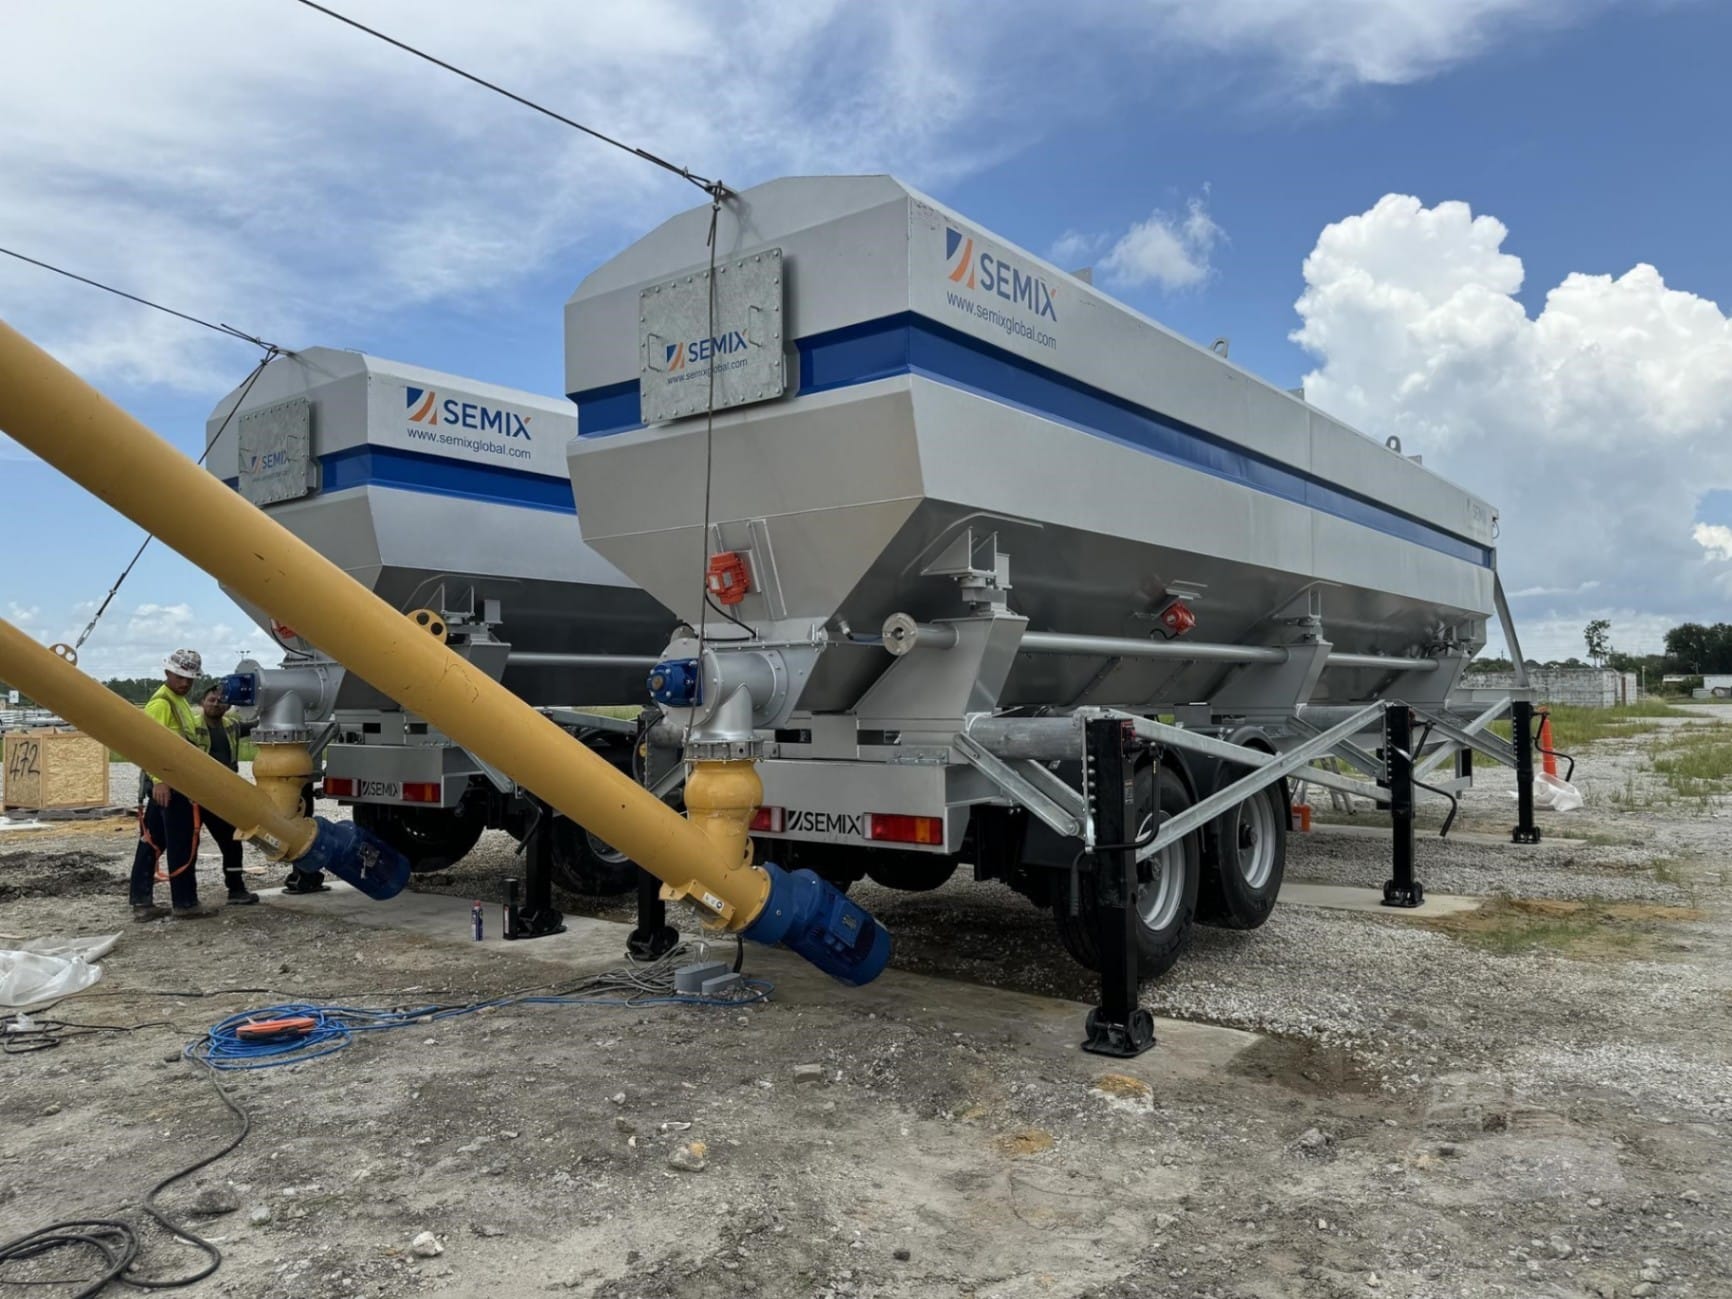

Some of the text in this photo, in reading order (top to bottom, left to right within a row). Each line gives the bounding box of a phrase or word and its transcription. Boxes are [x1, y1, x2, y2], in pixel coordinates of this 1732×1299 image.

[980, 252, 1057, 322] SEMIX
[946, 290, 1057, 350] www.semixglobal.com
[688, 328, 748, 363] SEMIX
[443, 399, 532, 441] SEMIX
[407, 427, 531, 460] www.semixglobal.com
[9, 740, 41, 782] 472
[803, 811, 862, 836] SEMIX
